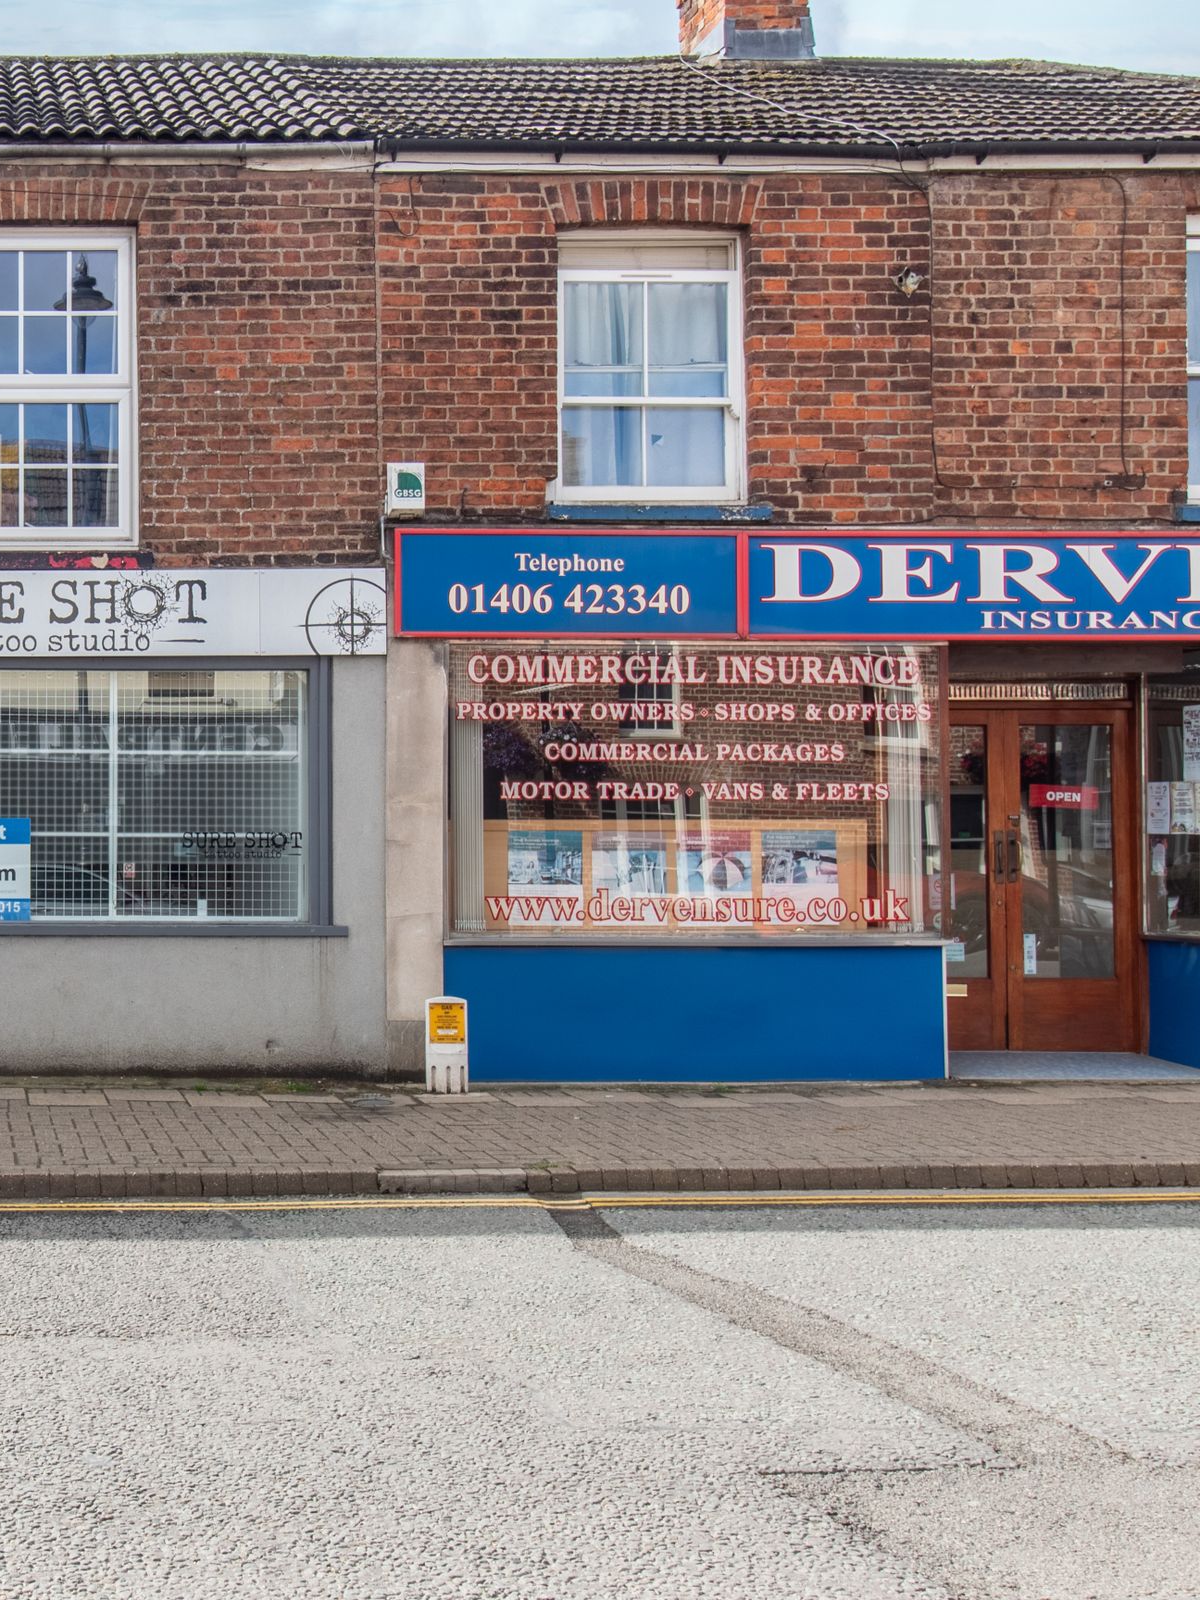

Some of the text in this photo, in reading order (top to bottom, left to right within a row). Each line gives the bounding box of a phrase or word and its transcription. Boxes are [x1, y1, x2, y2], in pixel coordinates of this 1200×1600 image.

[395, 489, 422, 497] GBSG
[514, 553, 625, 576] Telephone
[49, 577, 208, 628] SHOT
[448, 583, 690, 615] 01406 423340
[48, 629, 151, 653] studio
[467, 654, 920, 685] COMMERCIAL INSURANCE
[456, 702, 932, 721] PROPERTY OWNERS SHOPS & OFFICES
[544, 742, 845, 762] COMMERCIAL PACKAGES
[500, 781, 890, 801] MOTOR TRADE VANS & FLEETS
[1046, 790, 1082, 803] OPEN
[182, 831, 303, 850] SURE SHOT
[485, 888, 910, 923] www.dervensure.co.uk
